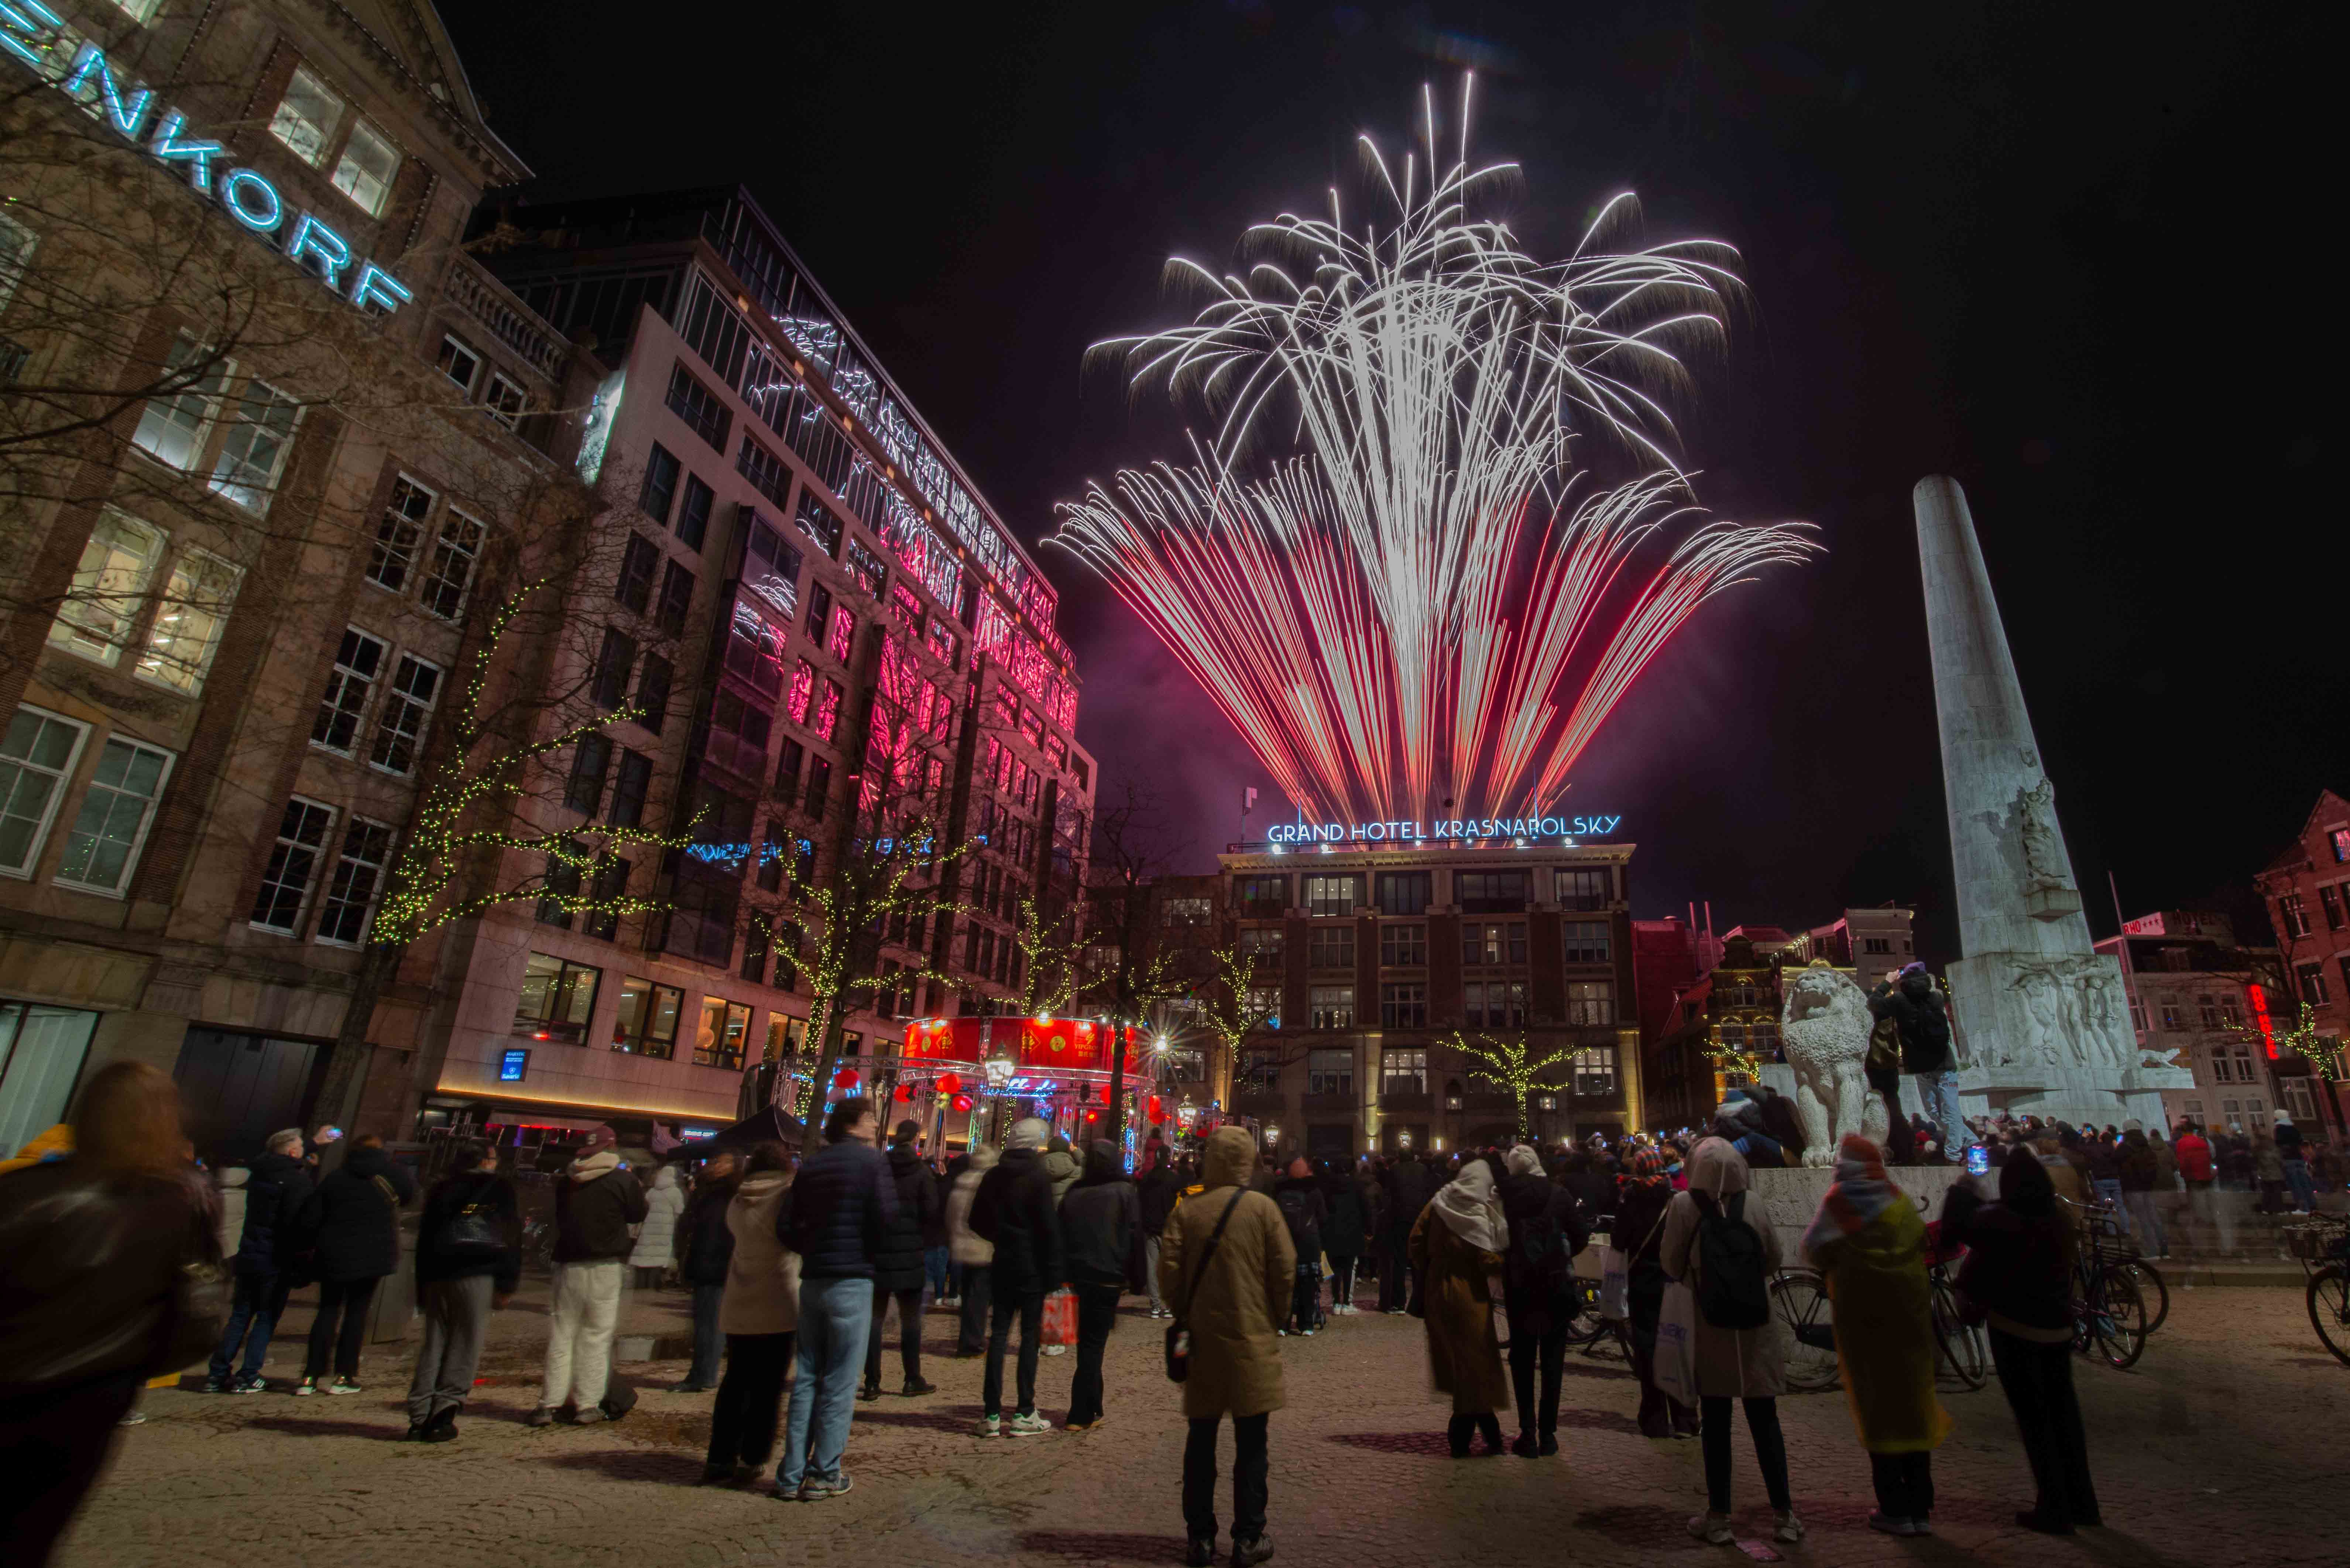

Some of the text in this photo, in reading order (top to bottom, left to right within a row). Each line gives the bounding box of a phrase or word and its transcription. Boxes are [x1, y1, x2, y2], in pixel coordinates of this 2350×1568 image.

[1268, 815, 1620, 842] GRAND HOTEL KRASNAPOLSKY
[2124, 920, 2141, 935] RHO
